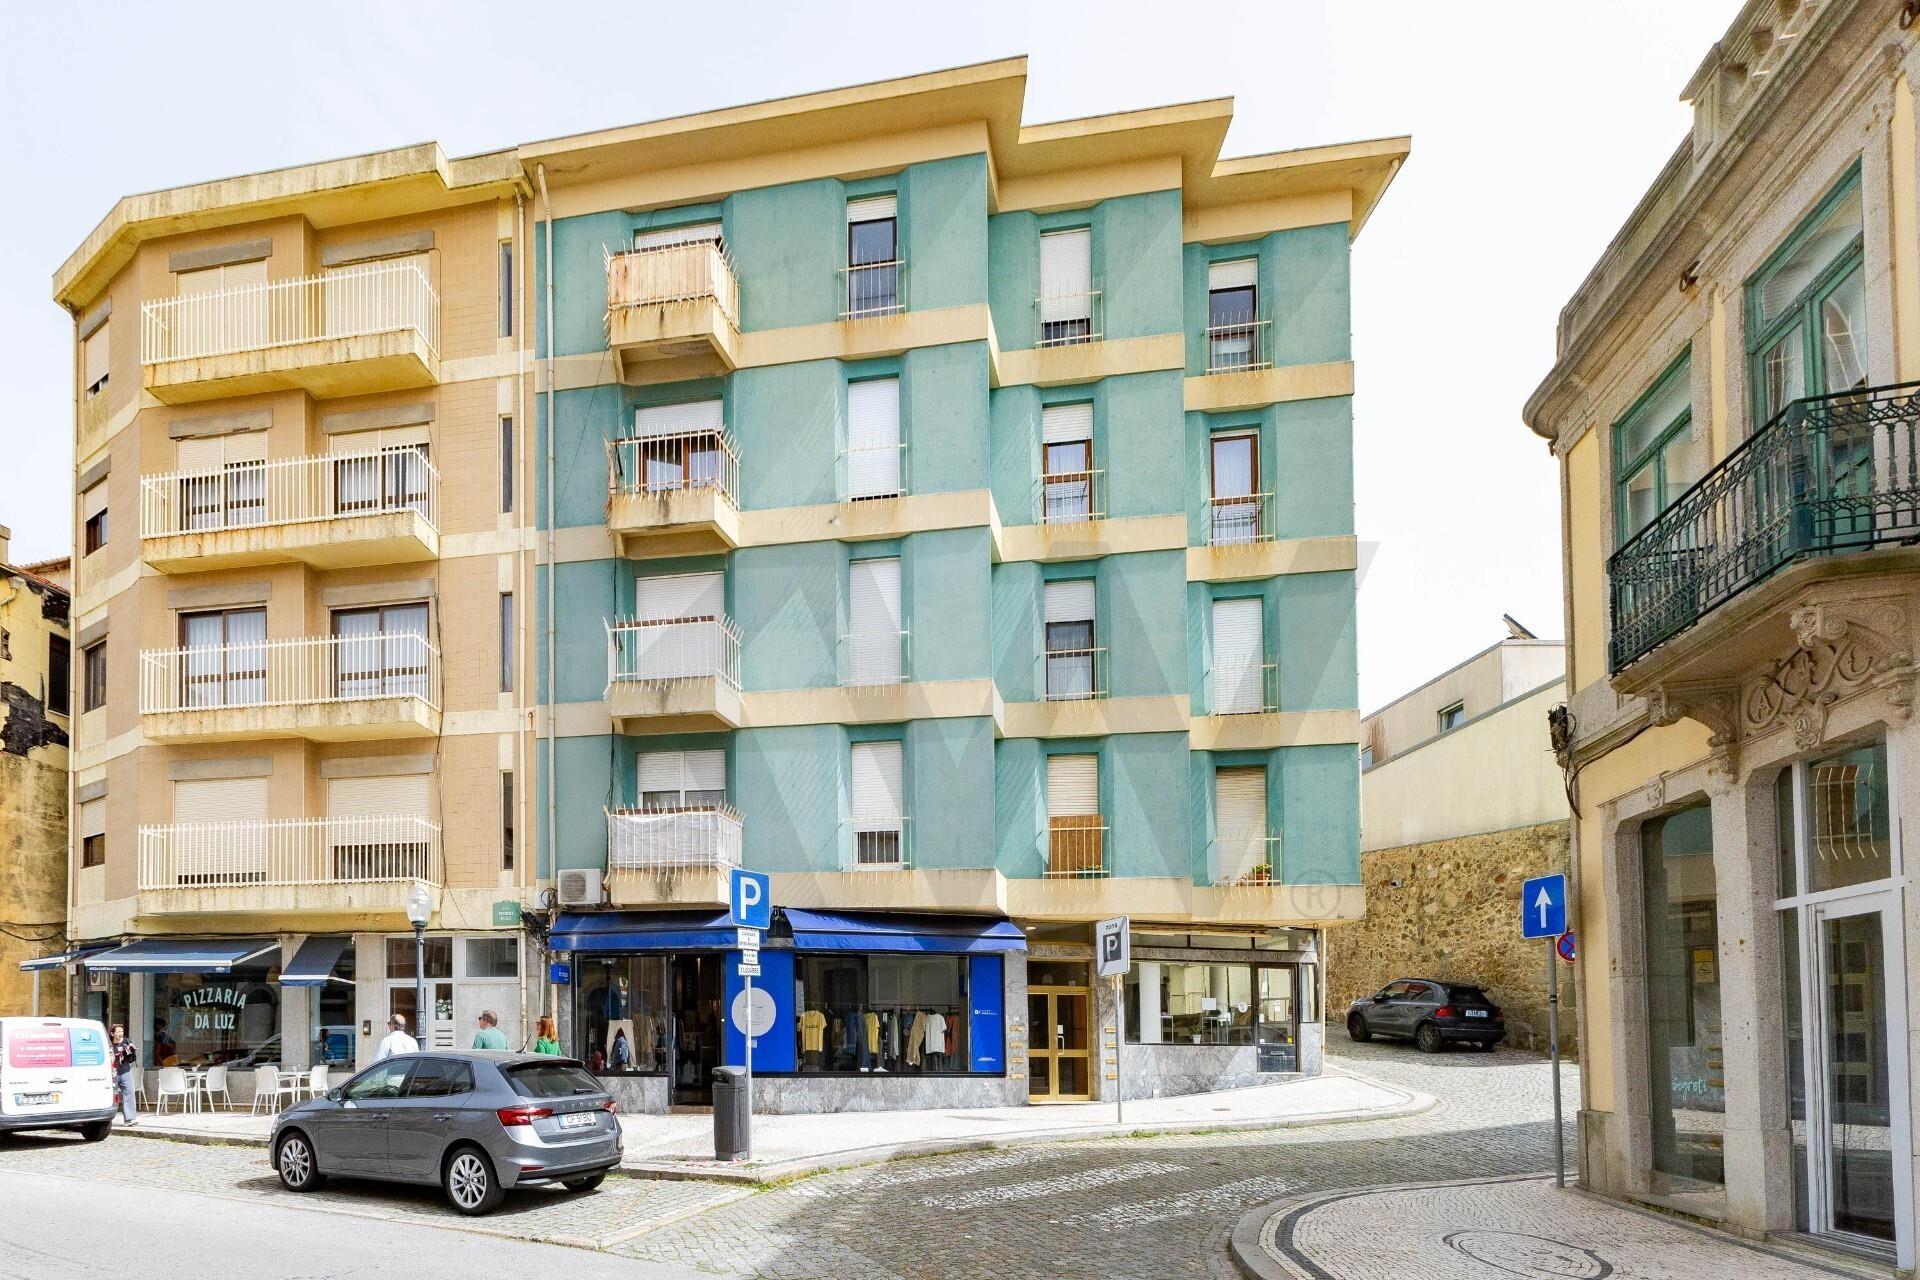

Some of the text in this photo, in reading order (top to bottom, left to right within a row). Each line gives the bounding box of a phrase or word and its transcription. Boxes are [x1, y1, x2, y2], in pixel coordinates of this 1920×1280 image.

[740, 876, 762, 921] P
[1106, 935, 1119, 960] P
[183, 986, 248, 1010] PIZZARIA
[194, 1013, 236, 1030] DA LUZ
